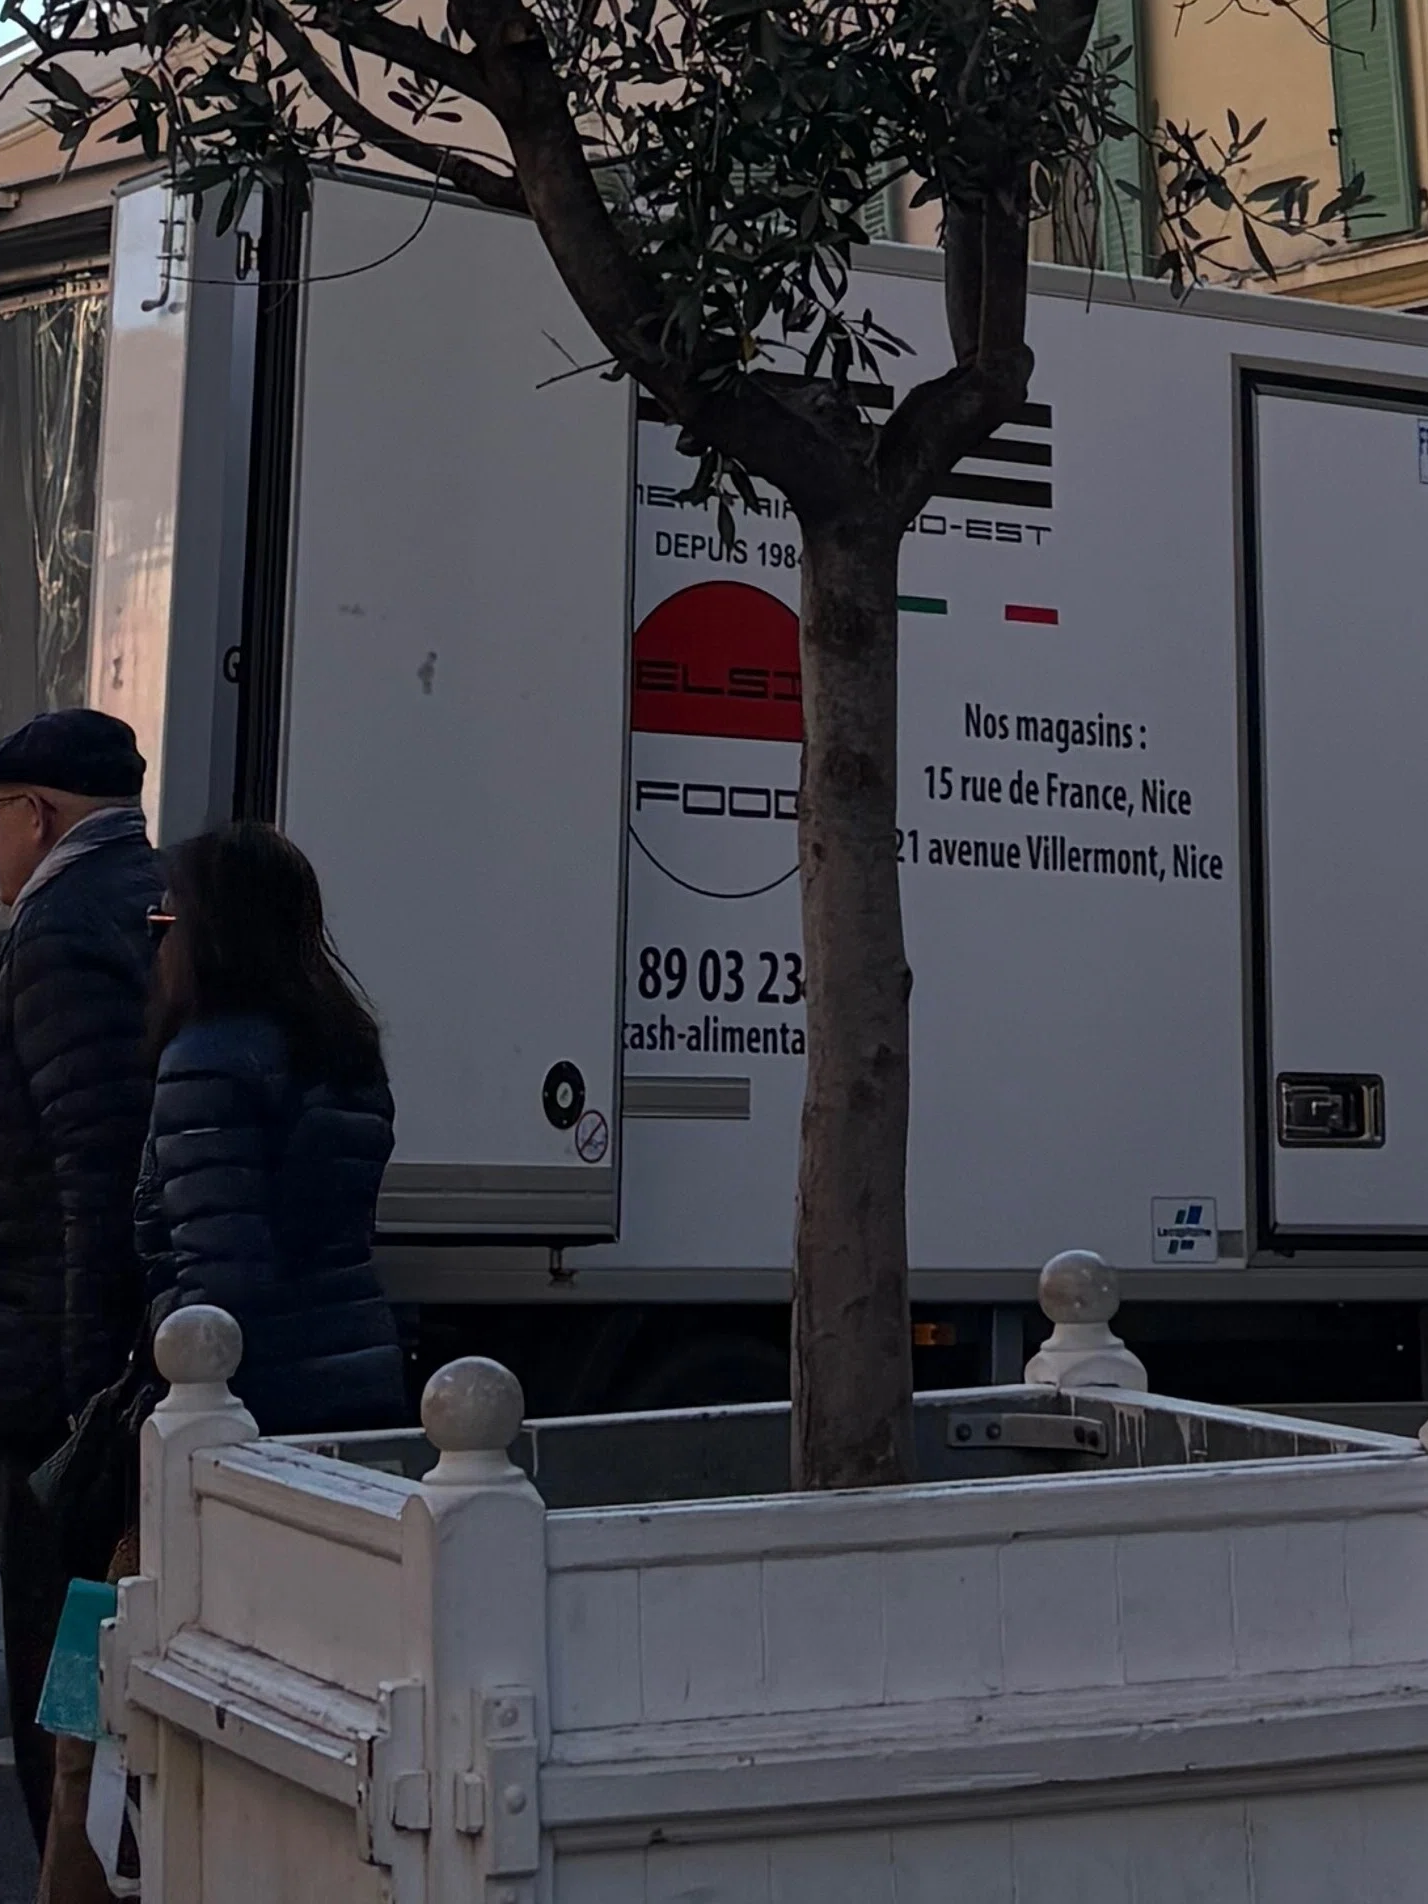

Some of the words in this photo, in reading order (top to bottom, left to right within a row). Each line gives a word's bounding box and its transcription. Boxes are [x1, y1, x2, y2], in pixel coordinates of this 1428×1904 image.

[655, 530, 748, 565] DEPUIS
[757, 541, 803, 569] 198
[964, 701, 1009, 741] Nos
[1015, 712, 1133, 753] magasins
[923, 765, 953, 800] 15
[960, 774, 1002, 803] rue
[1008, 769, 1040, 806] de
[1045, 771, 1134, 817] France,
[1141, 778, 1193, 816] Nice
[895, 828, 919, 864] 21
[928, 836, 1021, 869] avenue
[1026, 834, 1166, 883] Villermont,
[1172, 843, 1224, 881] Nice
[637, 946, 688, 1001] 89
[698, 948, 745, 1003] 03
[757, 951, 803, 1005] 23
